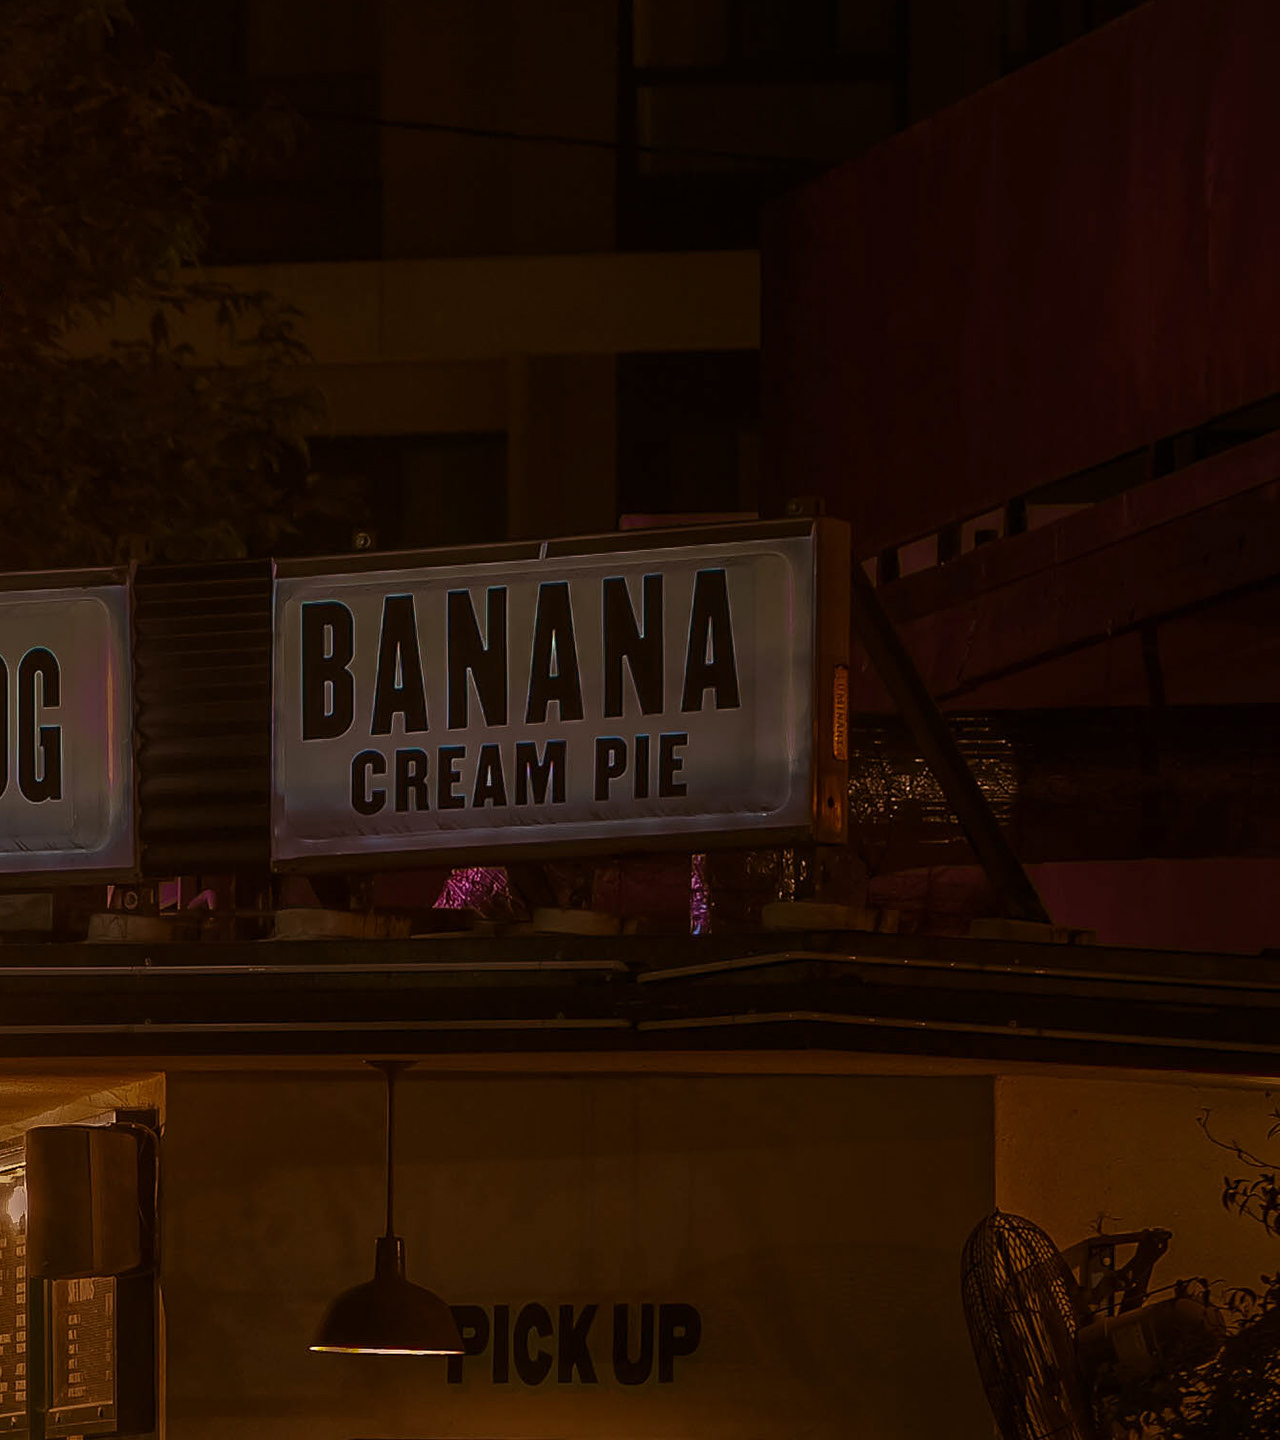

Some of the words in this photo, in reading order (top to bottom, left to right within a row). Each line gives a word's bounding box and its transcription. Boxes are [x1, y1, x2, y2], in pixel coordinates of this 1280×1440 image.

[298, 567, 742, 742] BANANA
[350, 740, 569, 817] CREAM
[592, 731, 690, 806] PIE
[448, 1302, 599, 1386] PICK
[611, 1302, 702, 1386] UP
